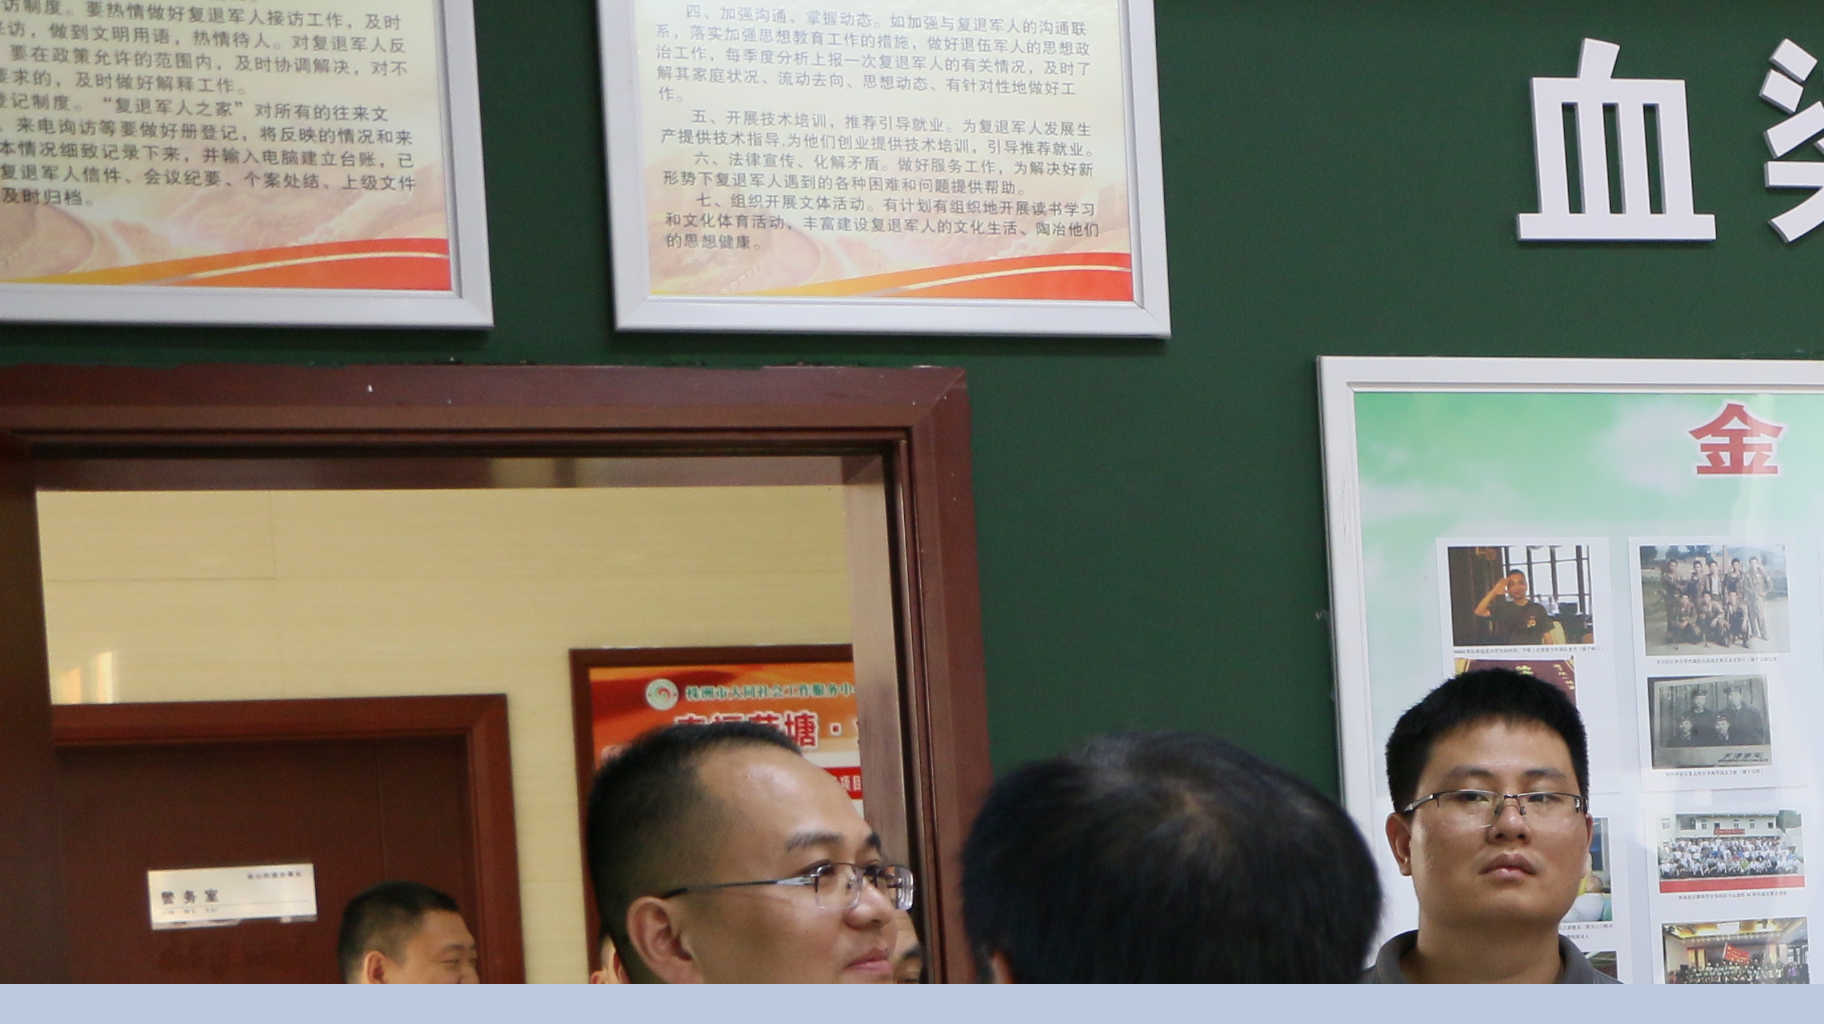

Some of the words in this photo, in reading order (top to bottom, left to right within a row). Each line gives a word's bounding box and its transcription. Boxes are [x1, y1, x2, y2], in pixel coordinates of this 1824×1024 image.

[0, 20, 406, 54] 访，做到文明用语，热情待人。对复退军人反
[658, 86, 684, 103] 作。
[685, 683, 856, 701] 株洲市大同社会工作服务中
